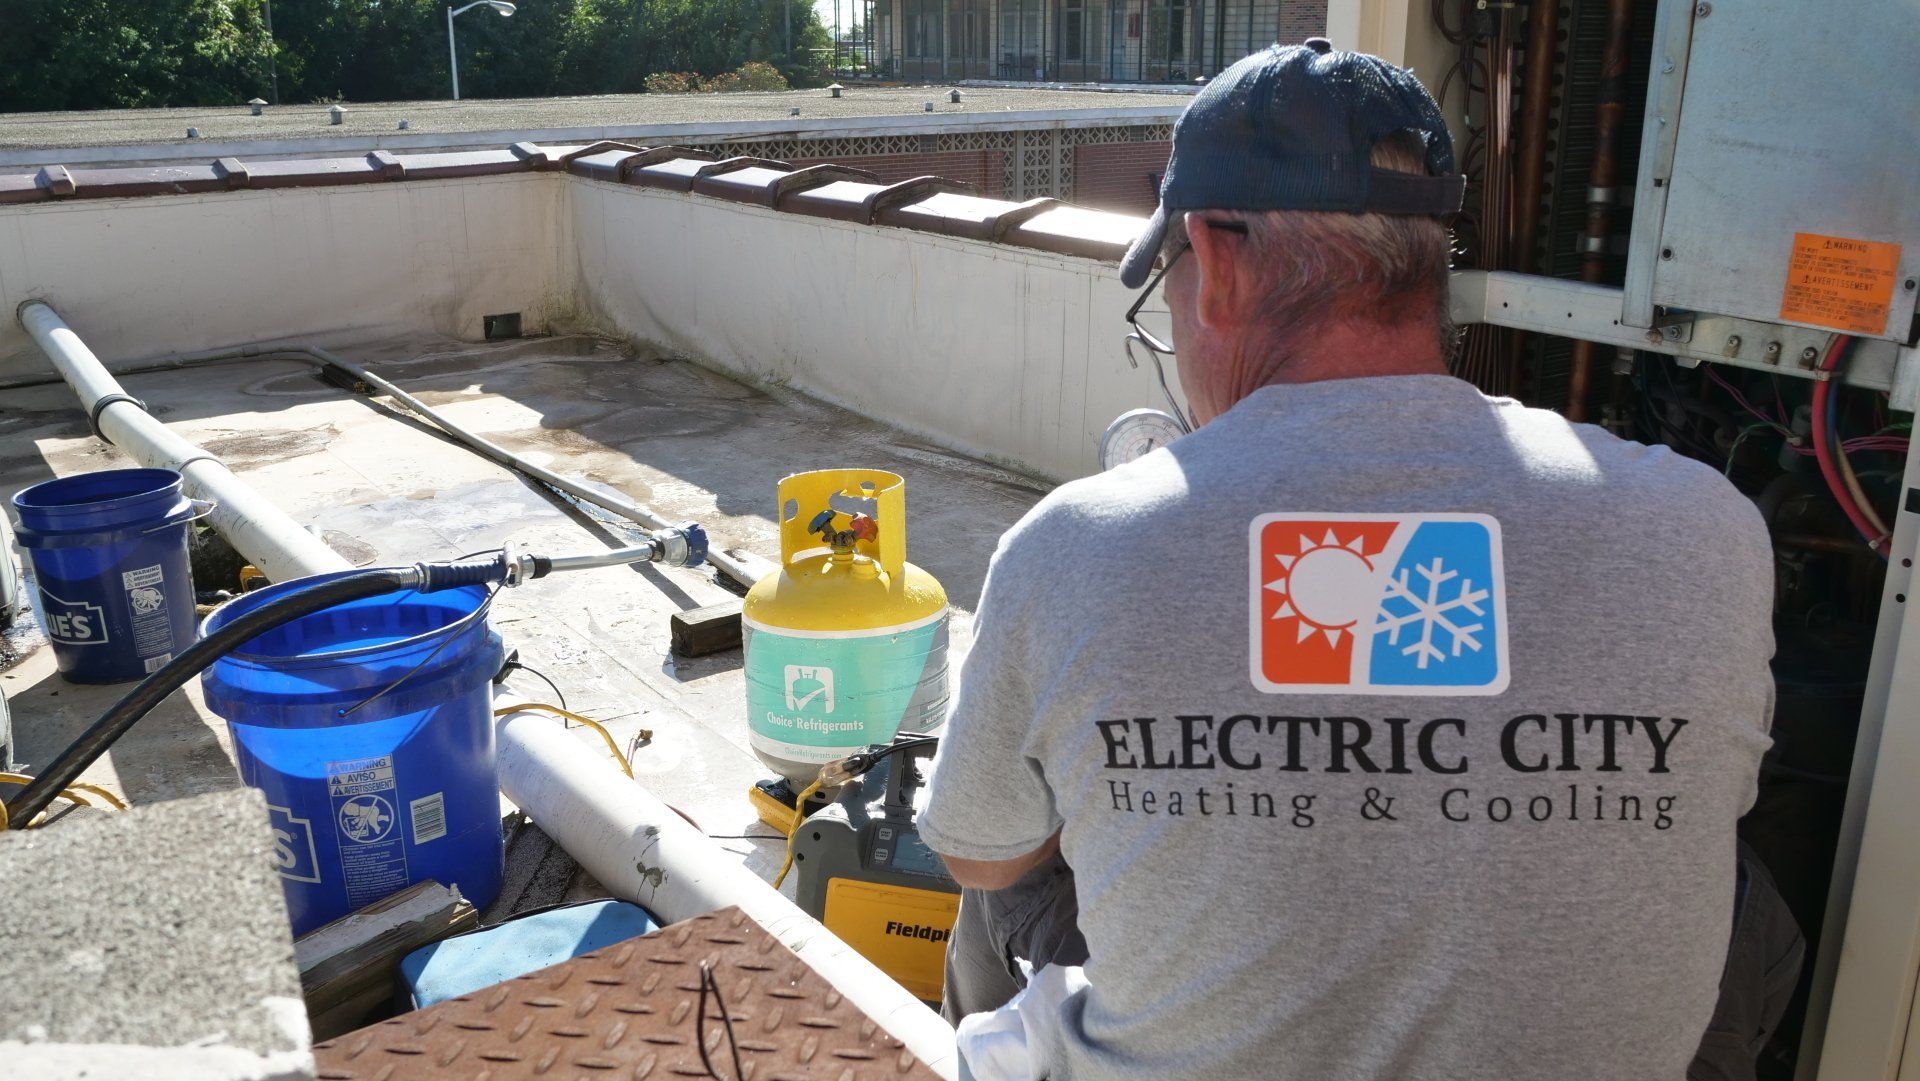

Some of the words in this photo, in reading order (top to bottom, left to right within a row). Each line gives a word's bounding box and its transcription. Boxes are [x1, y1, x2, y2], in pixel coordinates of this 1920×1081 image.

[1833, 241, 1868, 254] WARNING
[1813, 276, 1874, 292] AVERTISSEMENT
[766, 711, 793, 729] Choice
[796, 718, 864, 734] Refrigerants
[1095, 713, 1469, 774] ELECTRIC
[1500, 713, 1689, 774] CITY
[340, 758, 386, 772] WARNING
[347, 771, 376, 783] AVISO
[344, 780, 393, 794] AVERTISSEMENT
[1106, 780, 1317, 828] Heating
[1360, 787, 1398, 821] &
[1440, 784, 1677, 830] Cooling
